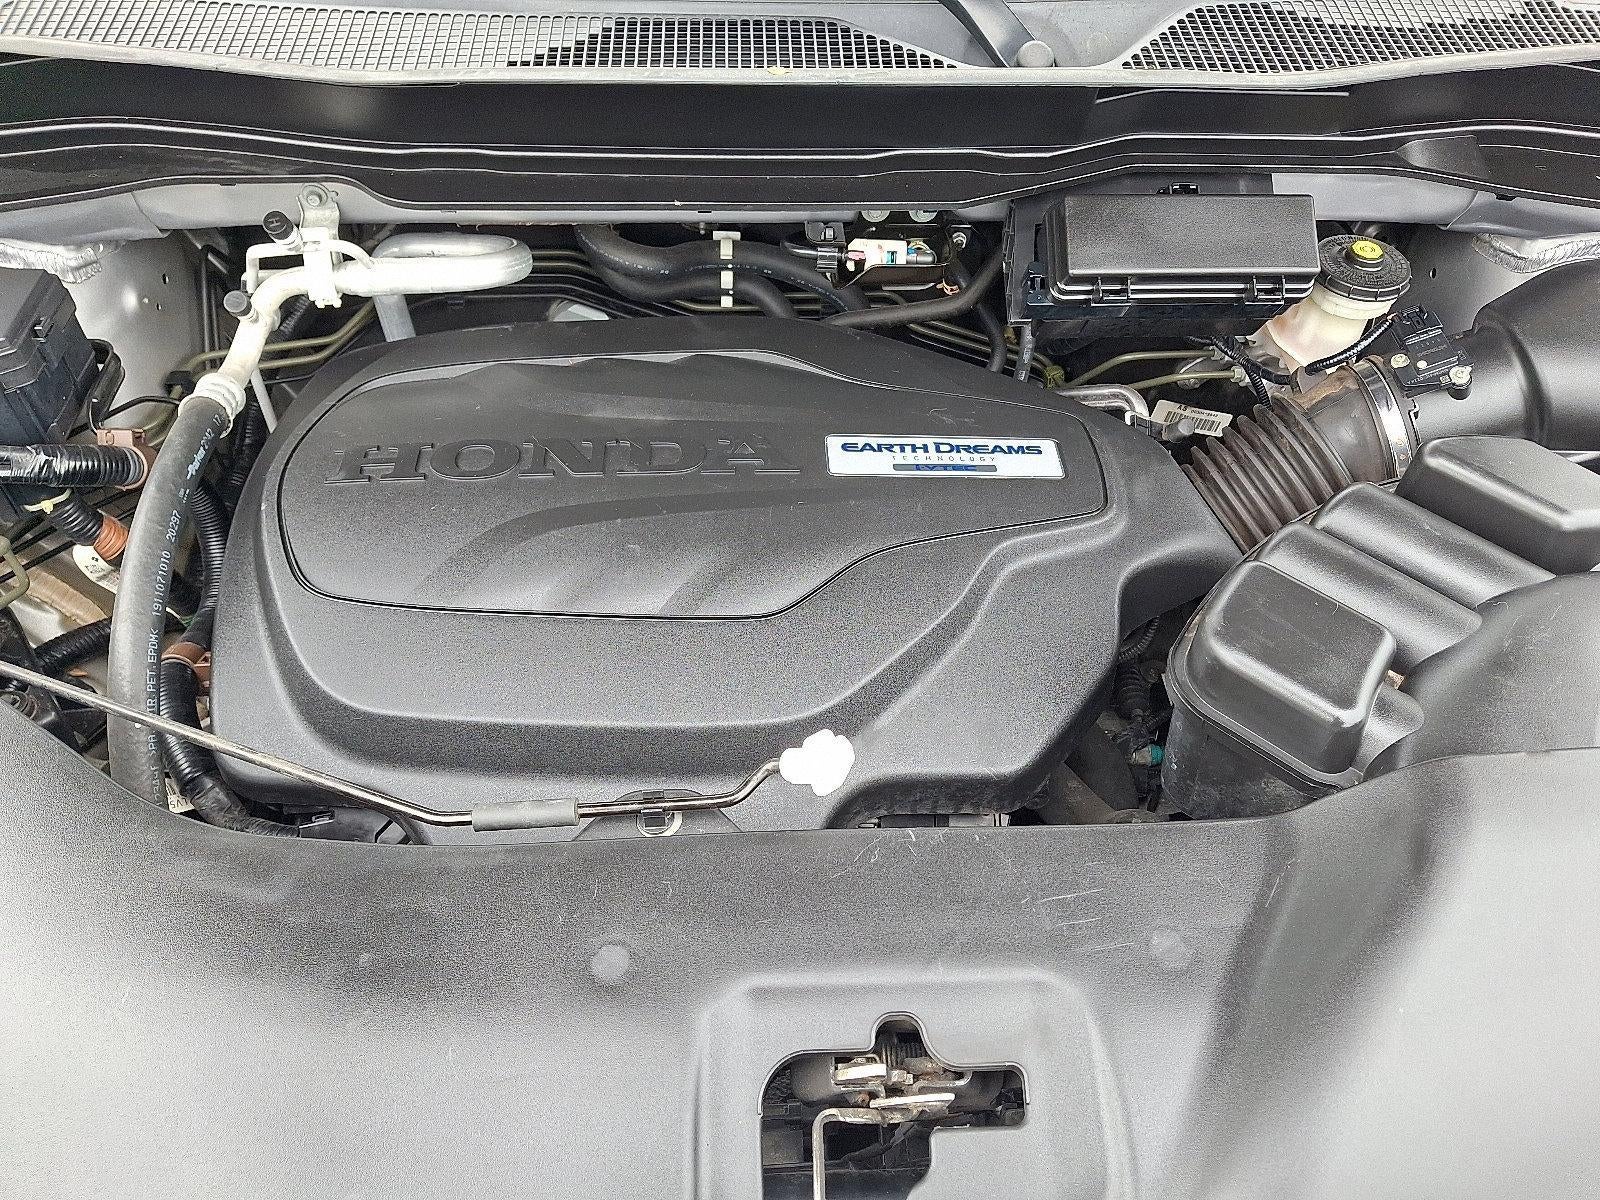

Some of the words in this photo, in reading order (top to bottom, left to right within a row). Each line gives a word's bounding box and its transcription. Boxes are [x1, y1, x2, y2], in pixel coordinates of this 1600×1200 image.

[324, 437, 800, 485] HONDA
[841, 442, 930, 454] EARTH
[933, 441, 1043, 456] DREAMS
[152, 550, 171, 616] 1911071010
[166, 510, 182, 543] 20297
